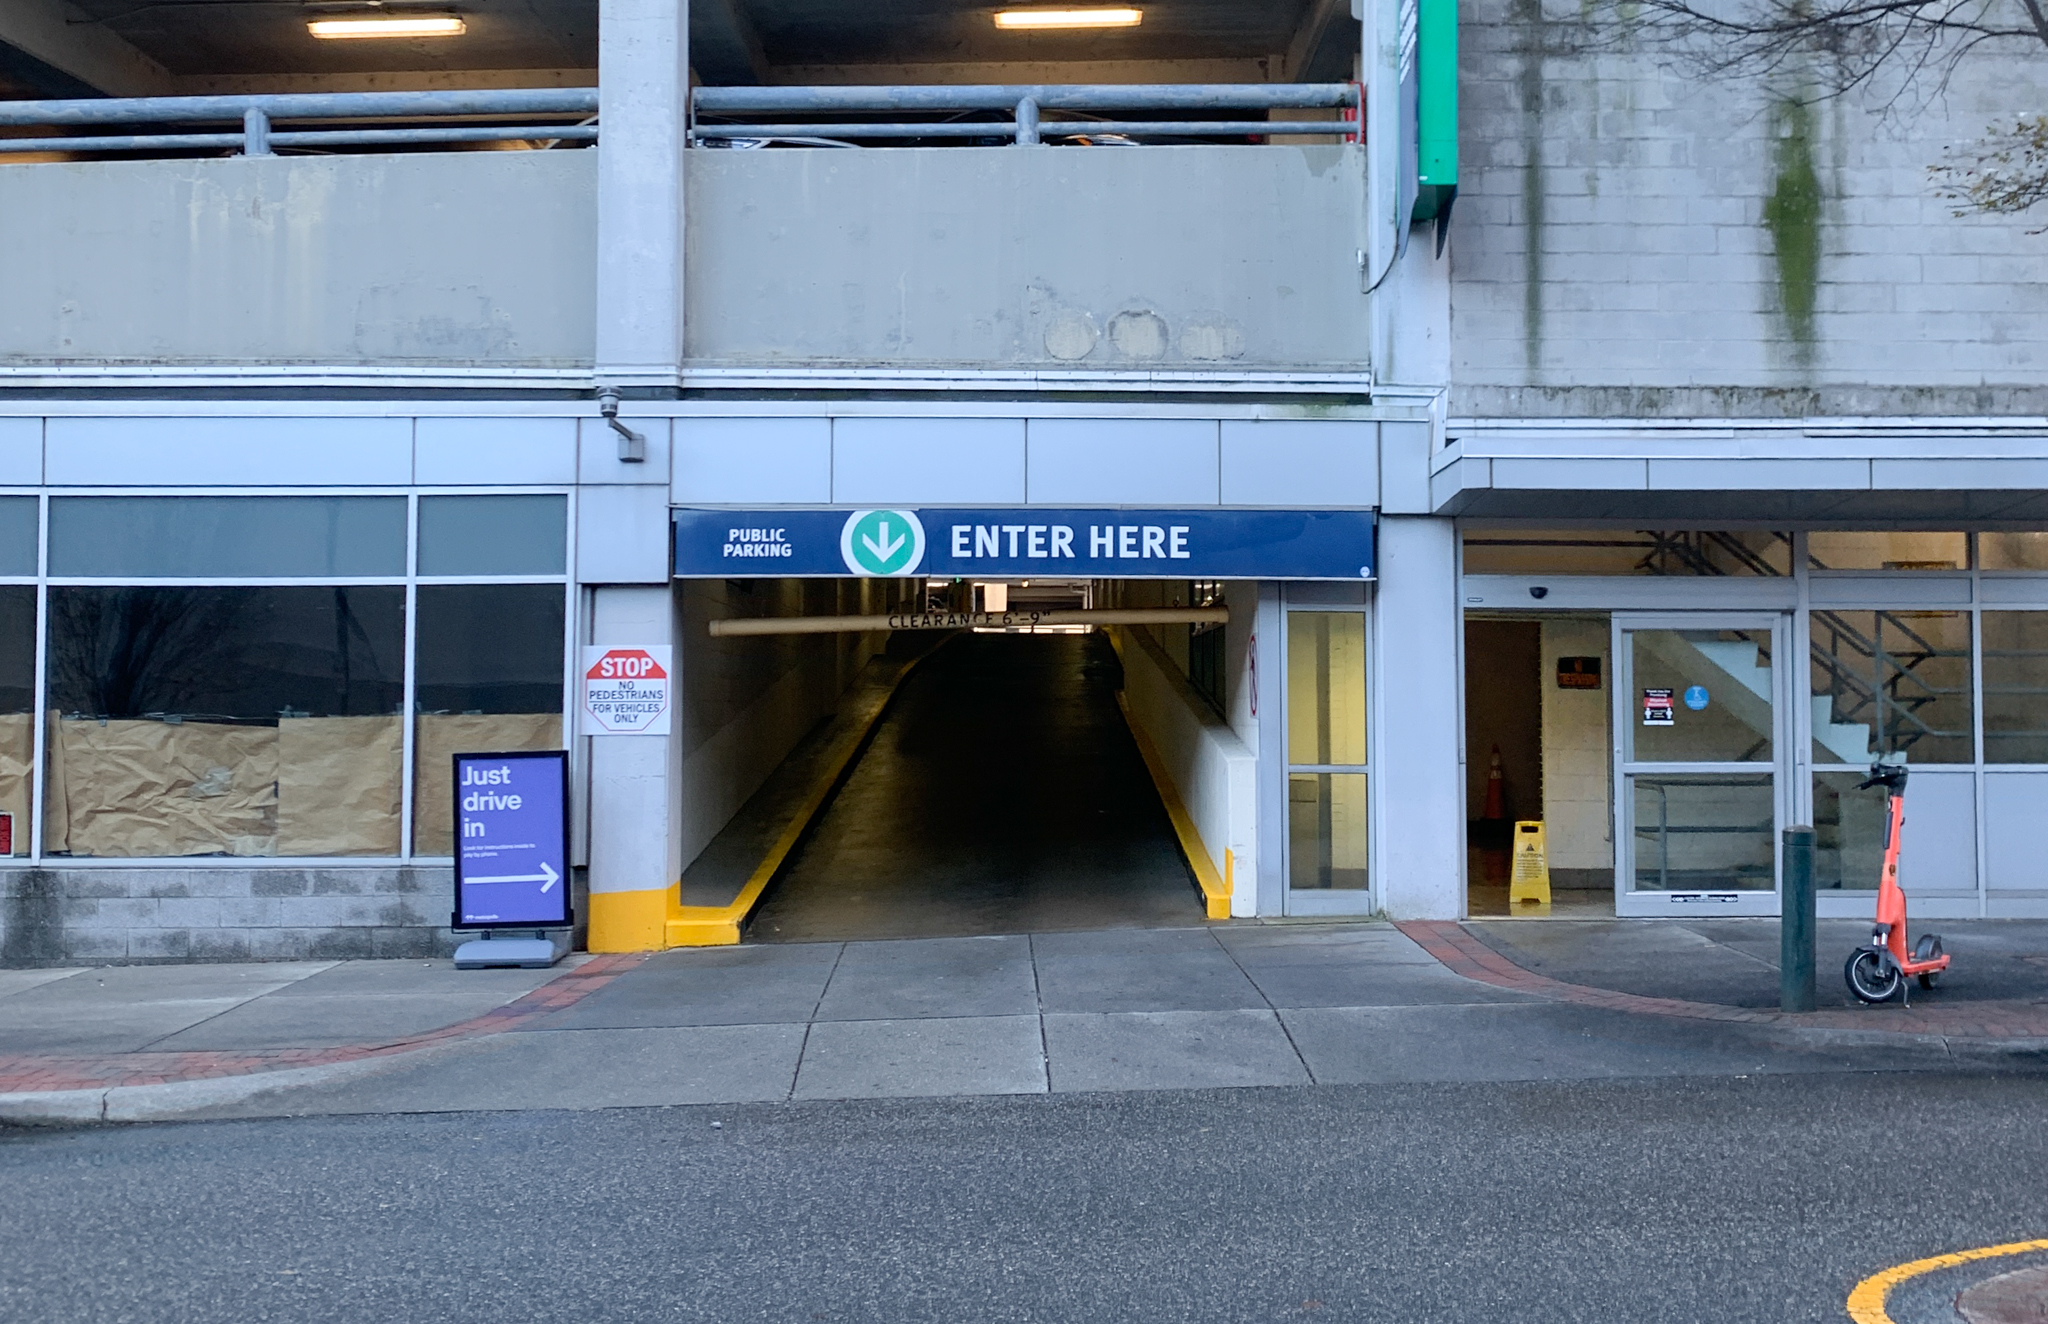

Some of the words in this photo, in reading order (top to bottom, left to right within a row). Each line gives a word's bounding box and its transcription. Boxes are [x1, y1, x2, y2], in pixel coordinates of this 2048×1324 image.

[728, 528, 786, 542] PUBLIC
[951, 525, 1076, 558] ENTER
[1089, 525, 1191, 559] HERE
[723, 543, 793, 557] PARKING
[600, 656, 655, 677] STOP
[618, 680, 635, 690] NO
[589, 690, 664, 700] PEDESTRIANS
[593, 703, 612, 713] FOR
[614, 703, 660, 713] VEHICLES
[613, 713, 639, 723] ONLY
[461, 765, 512, 786] Just
[463, 791, 523, 812] drive
[464, 817, 486, 838] in
